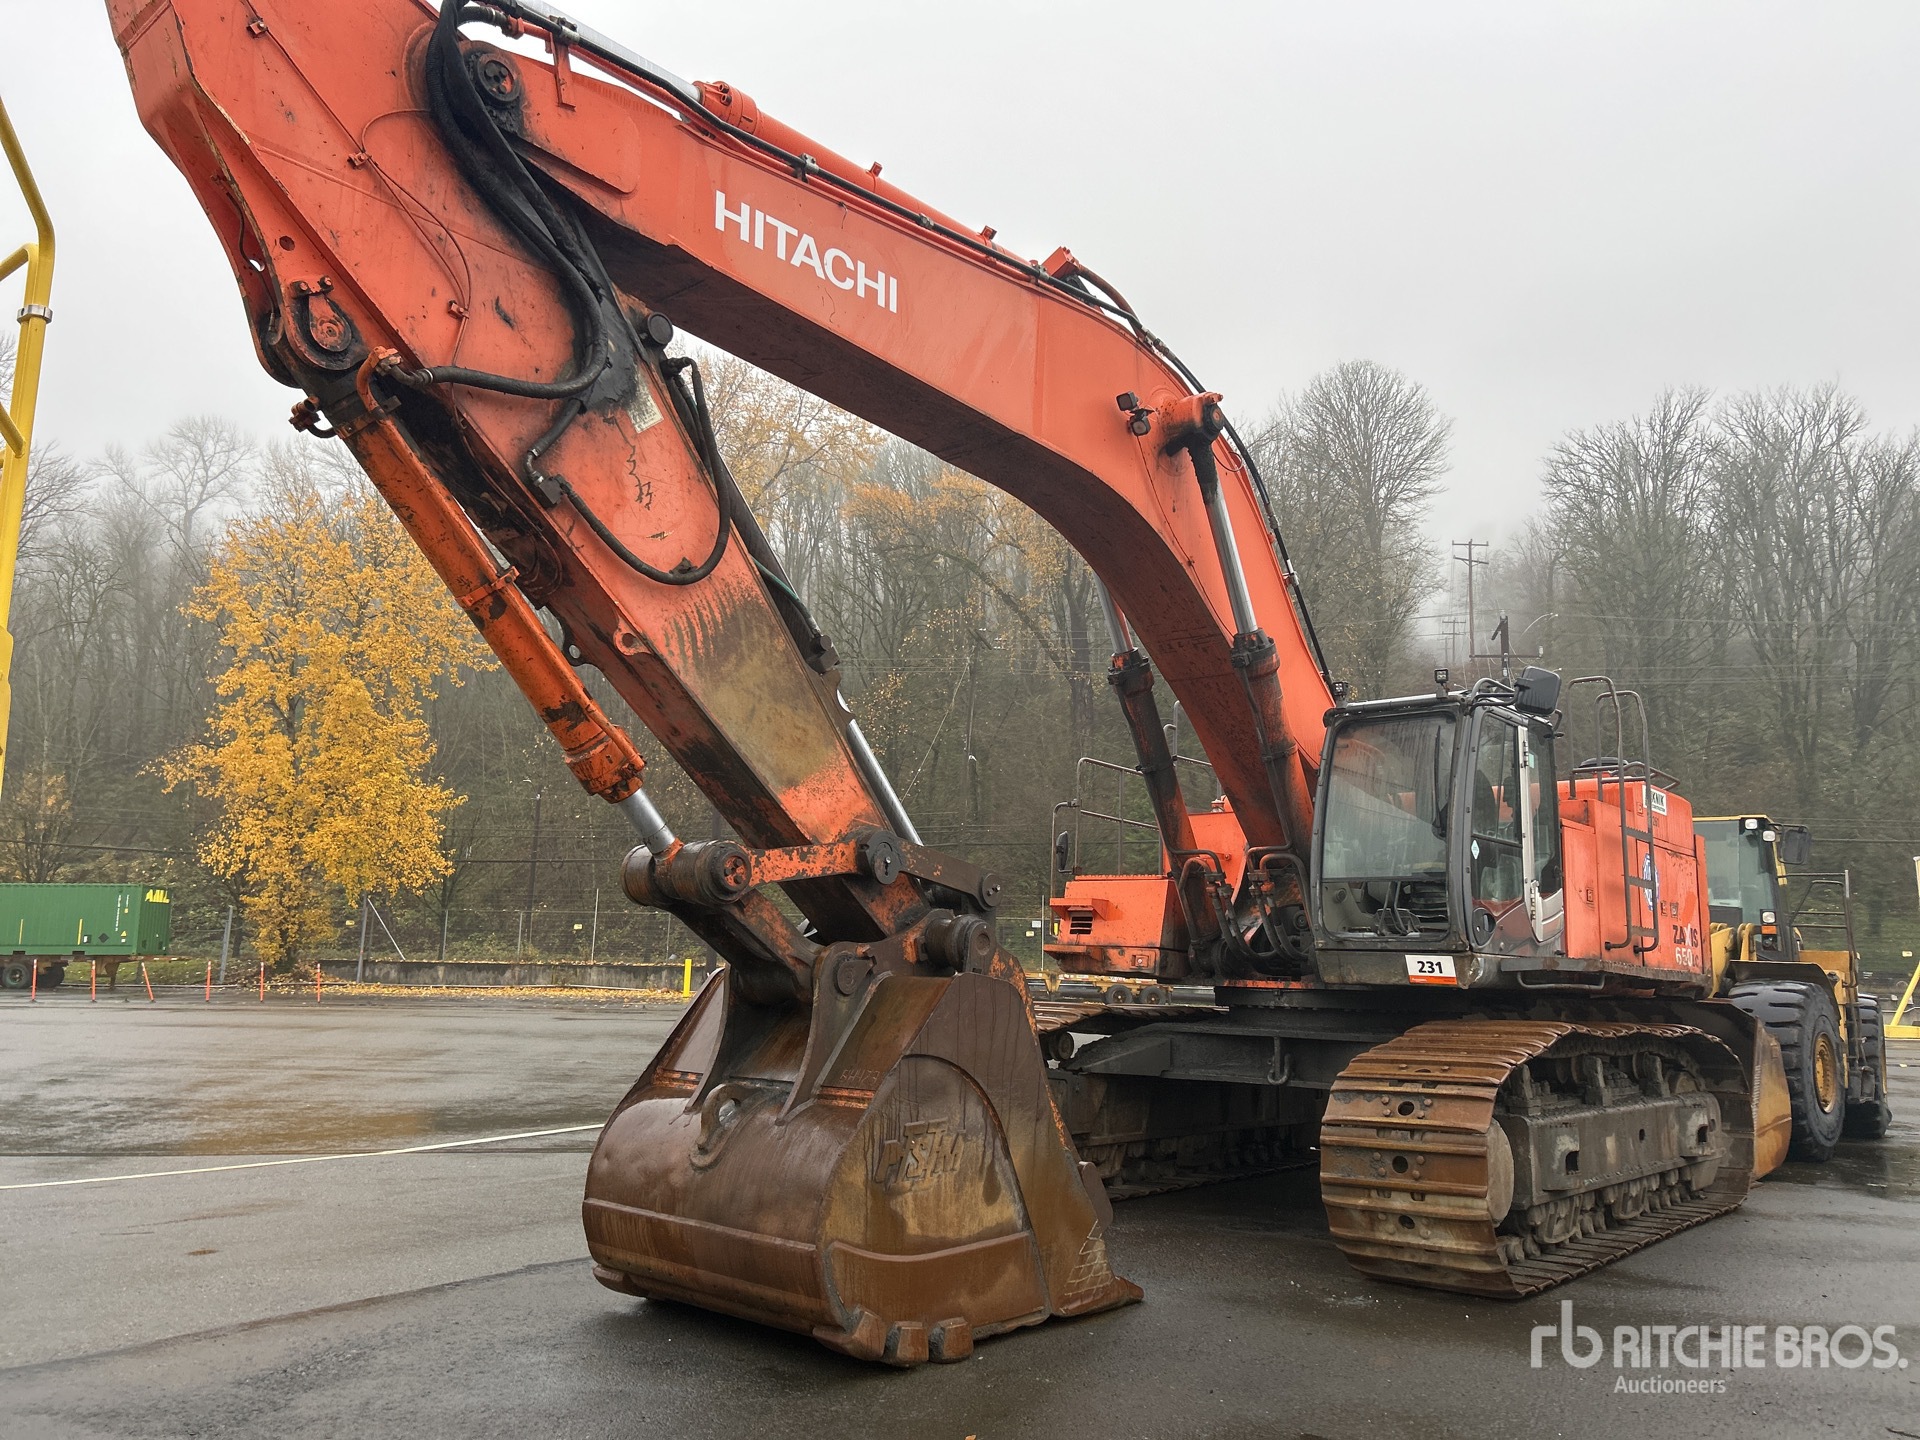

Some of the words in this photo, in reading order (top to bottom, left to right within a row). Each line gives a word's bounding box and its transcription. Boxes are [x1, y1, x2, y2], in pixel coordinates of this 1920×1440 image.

[715, 189, 898, 314] HITACHI
[1672, 924, 1699, 949] ZAXIS
[1417, 960, 1443, 974] 231
